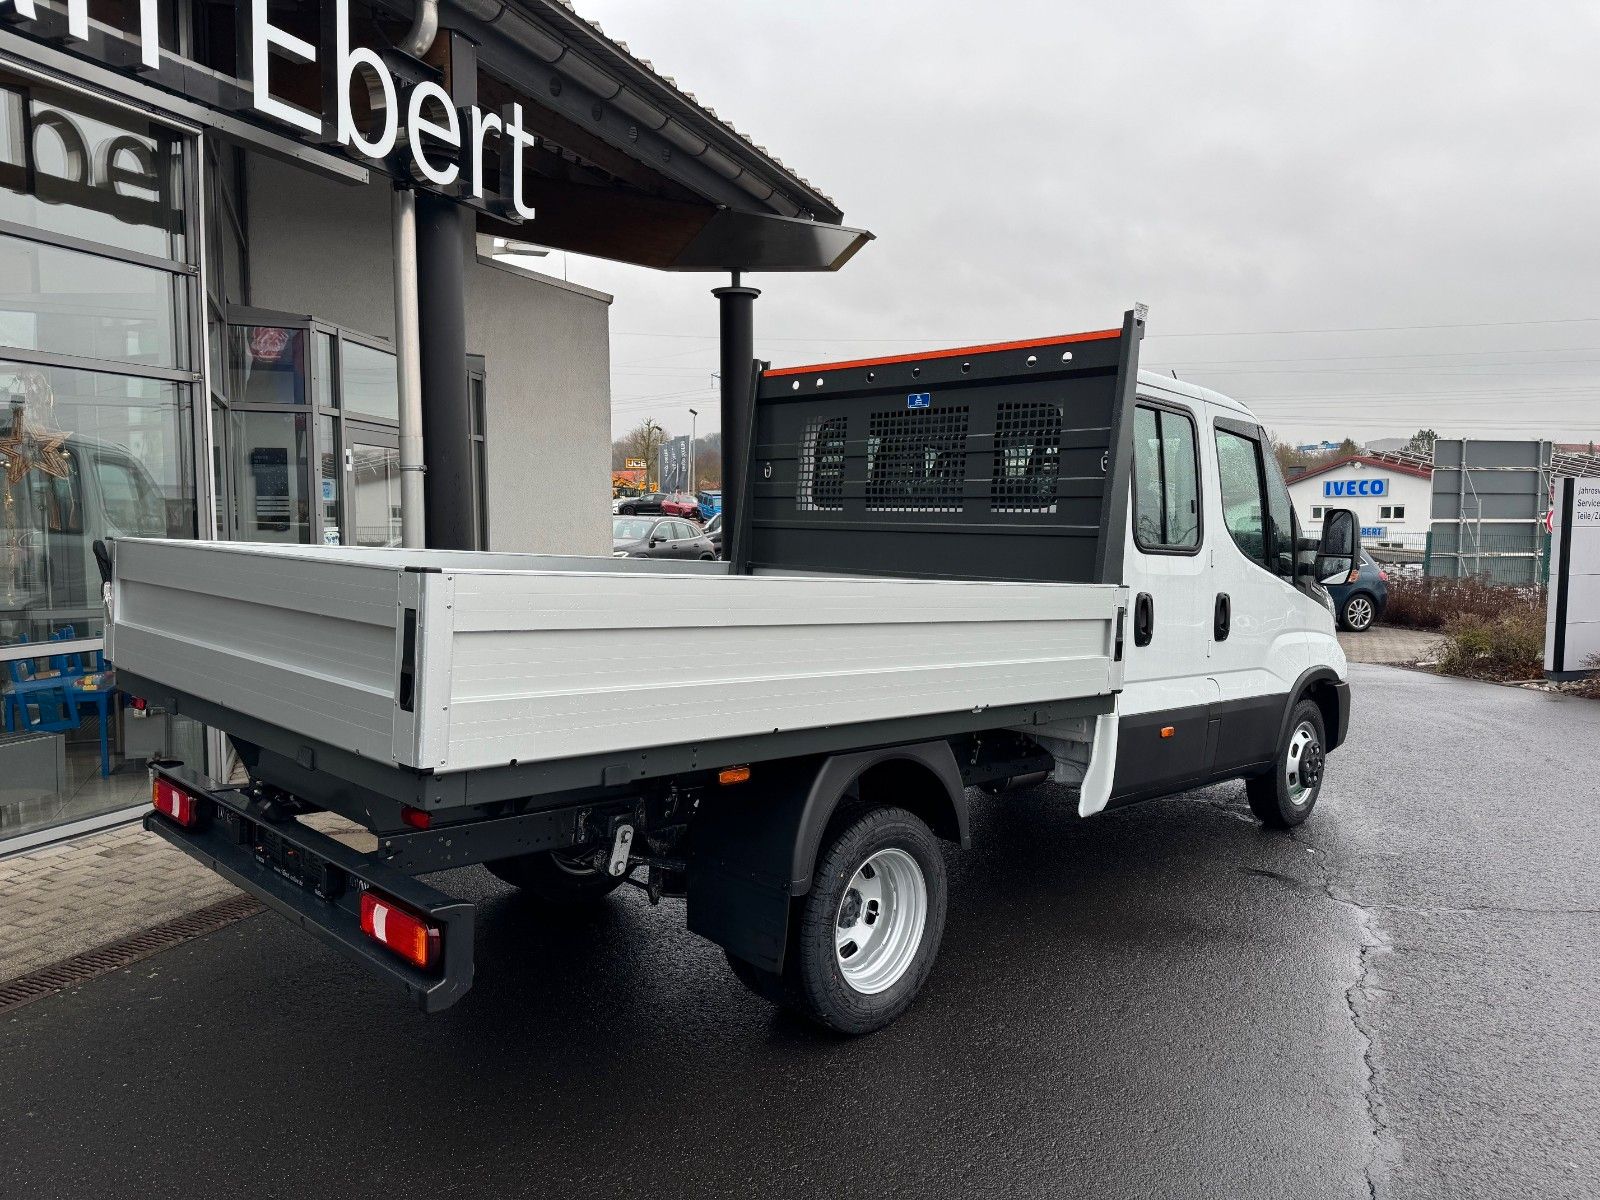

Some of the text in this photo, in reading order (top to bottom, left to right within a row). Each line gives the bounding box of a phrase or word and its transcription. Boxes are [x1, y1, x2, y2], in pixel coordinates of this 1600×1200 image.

[253, 0, 535, 220] Ebert
[1325, 480, 1384, 496] IVECO
[1360, 527, 1382, 536] BERT
